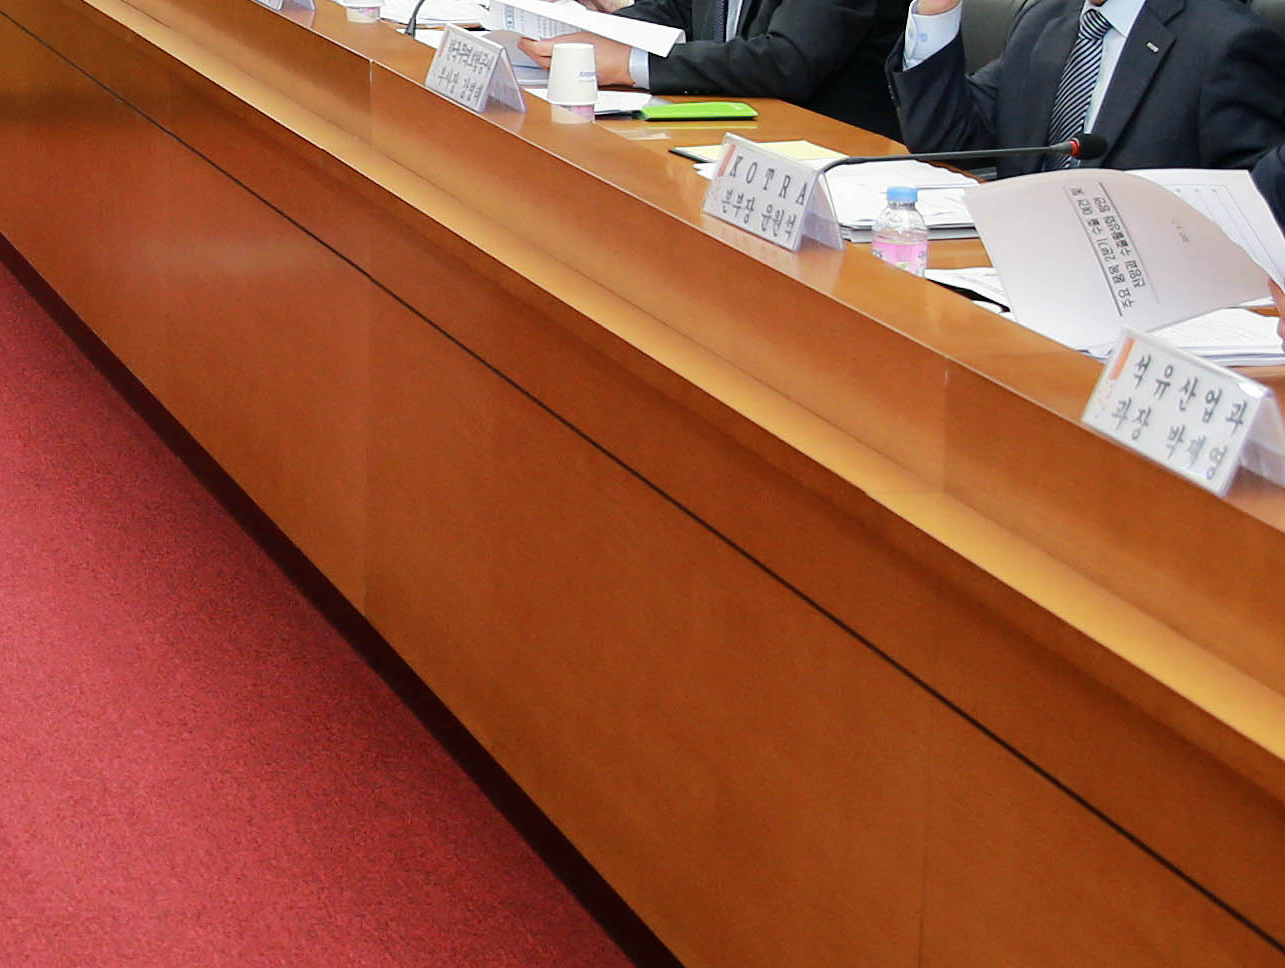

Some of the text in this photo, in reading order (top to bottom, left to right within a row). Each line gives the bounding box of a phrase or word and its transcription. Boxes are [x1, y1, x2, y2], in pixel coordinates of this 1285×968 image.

[729, 155, 808, 206] KOTRA
[721, 189, 755, 224] 본부장
[1085, 216, 1103, 236] 수출
[1095, 236, 1116, 263] 2분기
[1115, 286, 1135, 309] 주요
[1133, 354, 1248, 436] 석유산업과
[1111, 397, 1152, 441] 과장
